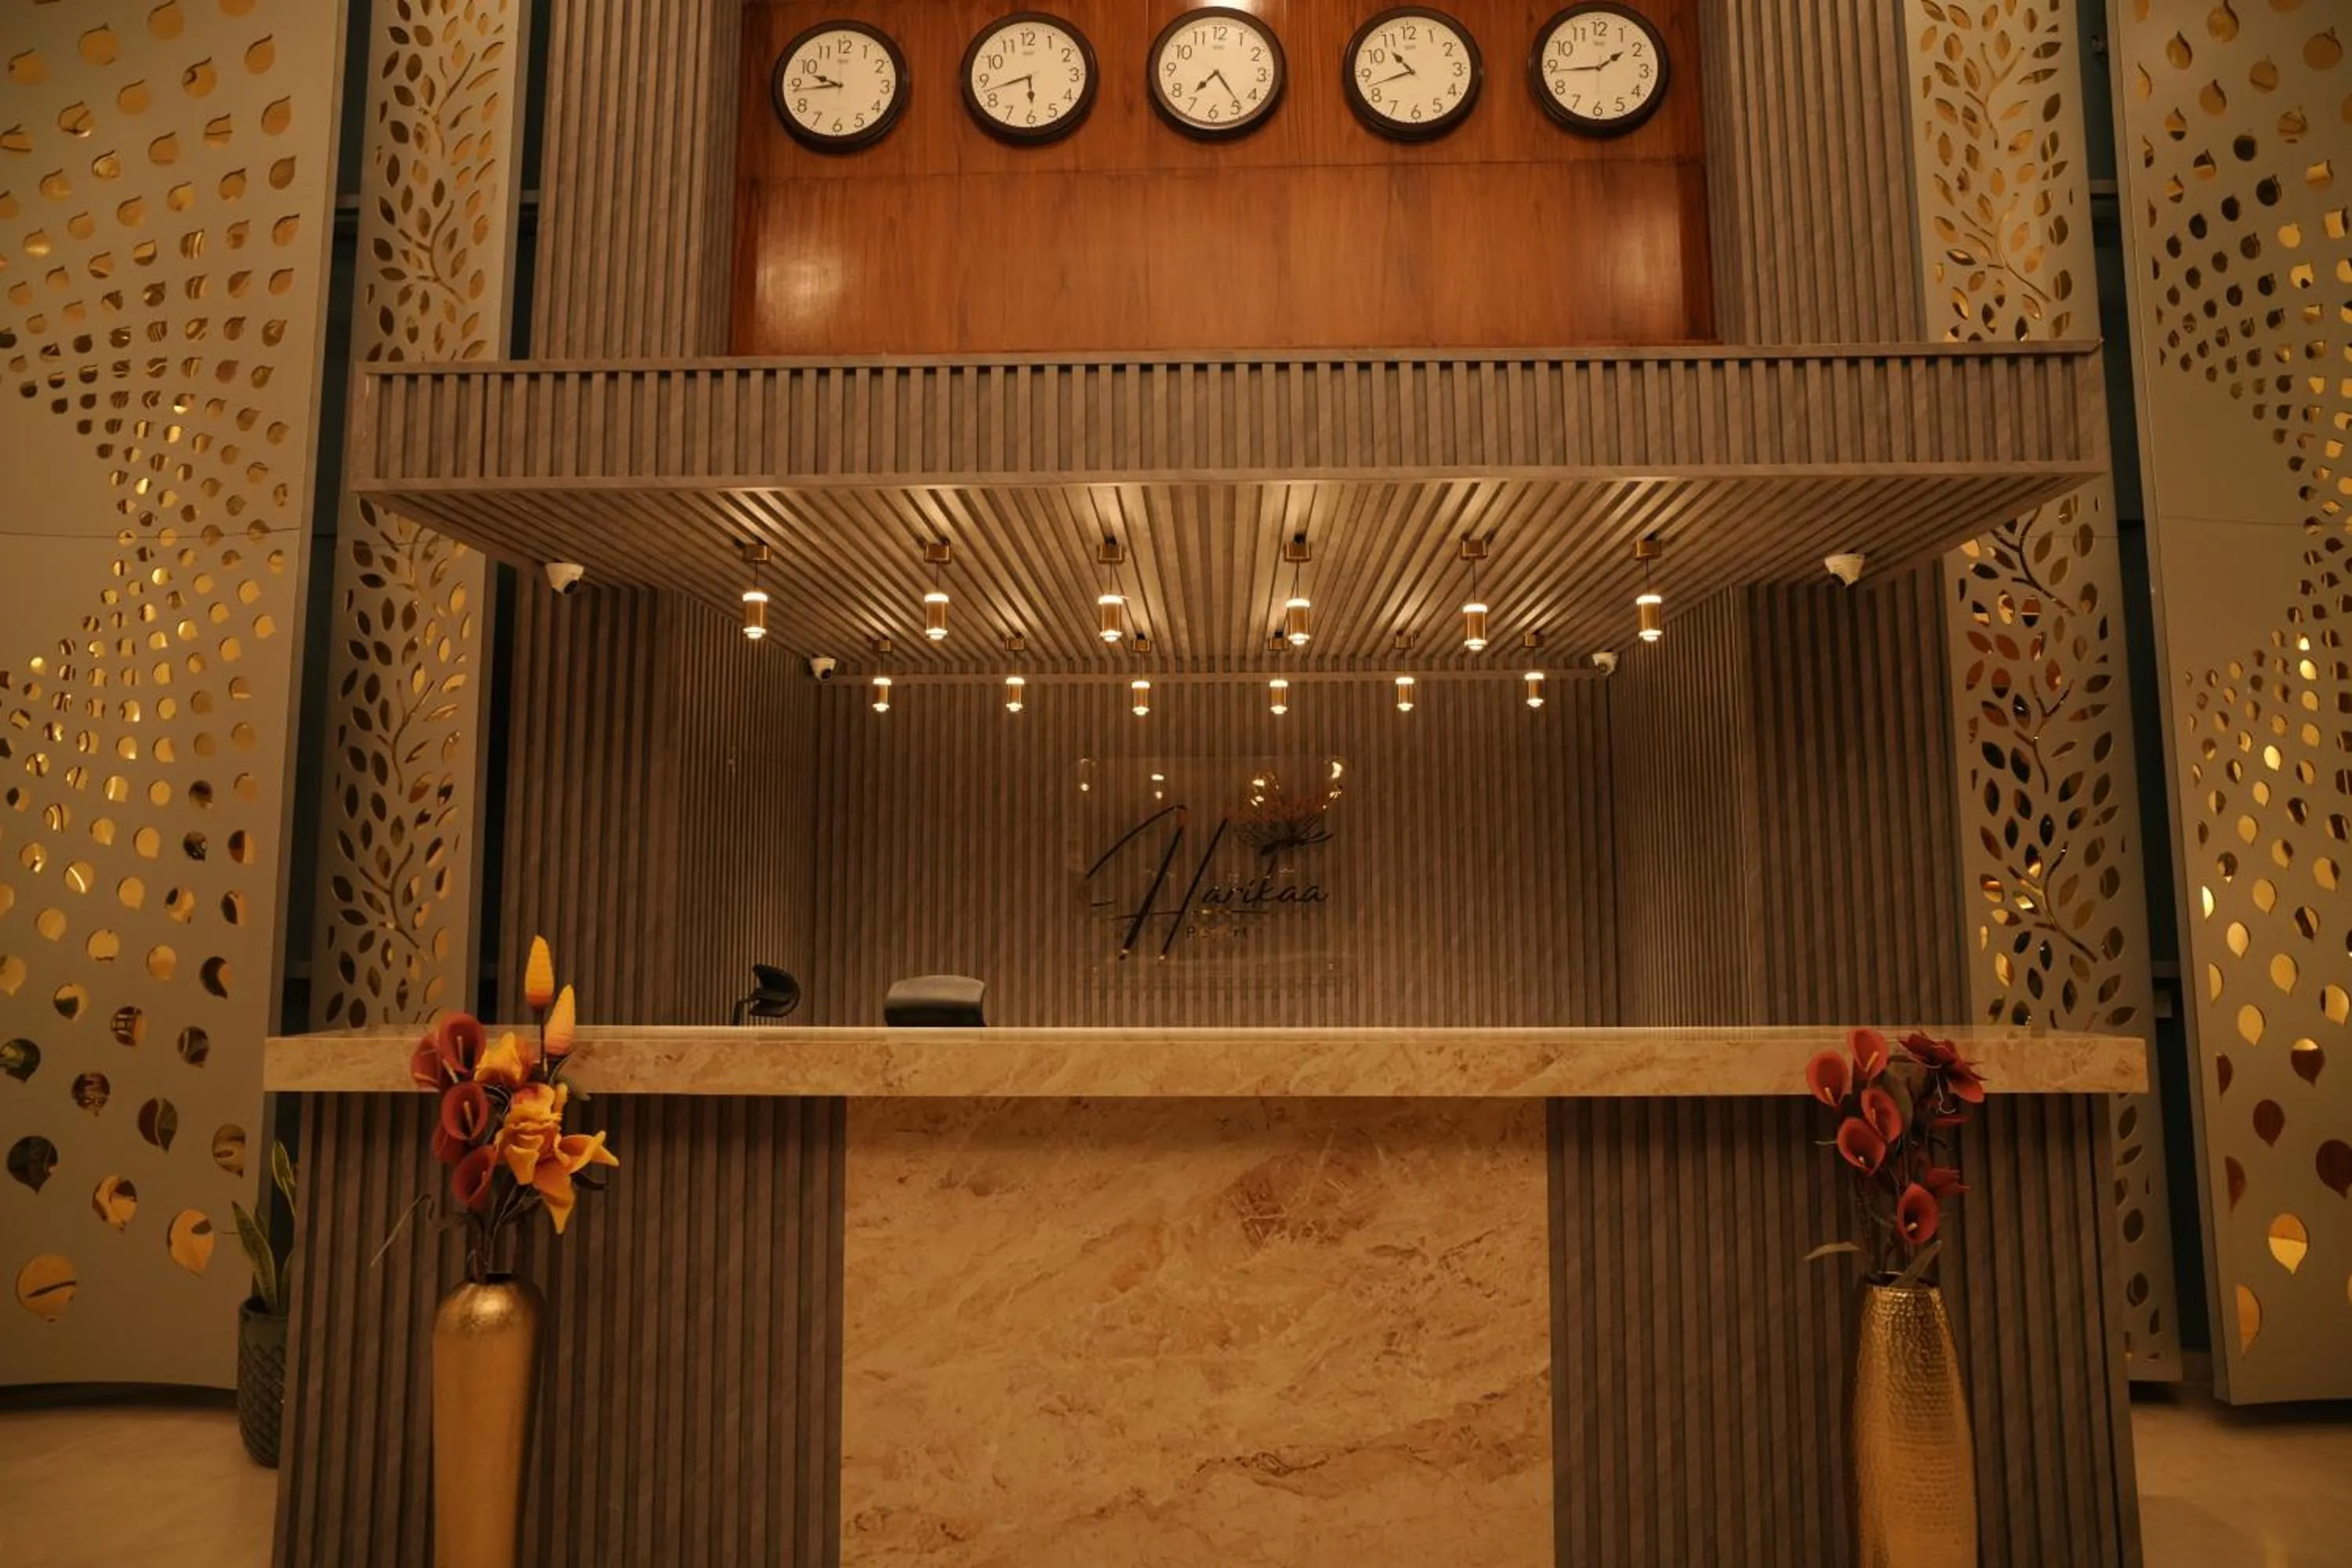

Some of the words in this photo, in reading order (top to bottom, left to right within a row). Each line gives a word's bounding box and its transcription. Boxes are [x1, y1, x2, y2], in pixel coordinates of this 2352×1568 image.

[1212, 27, 1228, 40] 12
[1400, 27, 1416, 40] 12
[1428, 29, 1433, 43] 1
[1573, 27, 1585, 42] 11
[1592, 22, 1607, 36] 12
[1618, 28, 1623, 43] 1
[1020, 31, 1036, 46] 12
[1047, 35, 1052, 49] 1
[1193, 31, 1205, 45] 11
[1239, 33, 1243, 45] 1
[1382, 34, 1396, 48] 11
[818, 45, 830, 59] 11
[837, 39, 852, 54] 12
[862, 45, 868, 58] 1
[1002, 39, 1014, 54] 11
[1176, 45, 1192, 60] 10
[1443, 42, 1452, 56] 2
[1556, 41, 1573, 56] 10
[1632, 42, 1642, 56] 2
[987, 54, 1003, 69] 10
[1062, 48, 1070, 63] 2
[1250, 47, 1261, 62] 2
[1367, 49, 1385, 64] 10
[801, 59, 817, 74] 10
[875, 60, 884, 73] 2
[1167, 63, 1176, 77] 9
[1453, 62, 1463, 77] 3
[1548, 60, 1558, 74] 9
[1639, 64, 1649, 78] 3
[980, 74, 989, 88] 9
[1069, 67, 1079, 82] 3
[1257, 67, 1266, 82] 3
[1361, 68, 1371, 82] 9
[792, 78, 802, 92] 9
[880, 80, 890, 94] 3
[1171, 83, 1181, 97] 8
[1447, 83, 1457, 96] 4
[1555, 79, 1565, 95] 8
[1631, 85, 1640, 97] 4
[988, 93, 998, 107] 8
[1063, 89, 1072, 101] 4
[1247, 88, 1257, 100] 4
[1372, 88, 1381, 103] 8
[797, 99, 807, 113] 8
[872, 100, 880, 113] 4
[1188, 97, 1197, 111] 7
[1230, 100, 1240, 115] 5
[1389, 100, 1399, 115] 7
[1433, 98, 1443, 113] 5
[1572, 94, 1581, 109] 7
[1593, 101, 1602, 116] 6
[1614, 97, 1624, 111] 5
[1005, 105, 1013, 120] 7
[1026, 110, 1036, 124] 6
[1048, 103, 1057, 118] 5
[1208, 104, 1218, 119] 6
[1411, 103, 1421, 119] 6
[813, 111, 822, 125] 7
[833, 118, 842, 132] 6
[855, 113, 864, 128] 5
